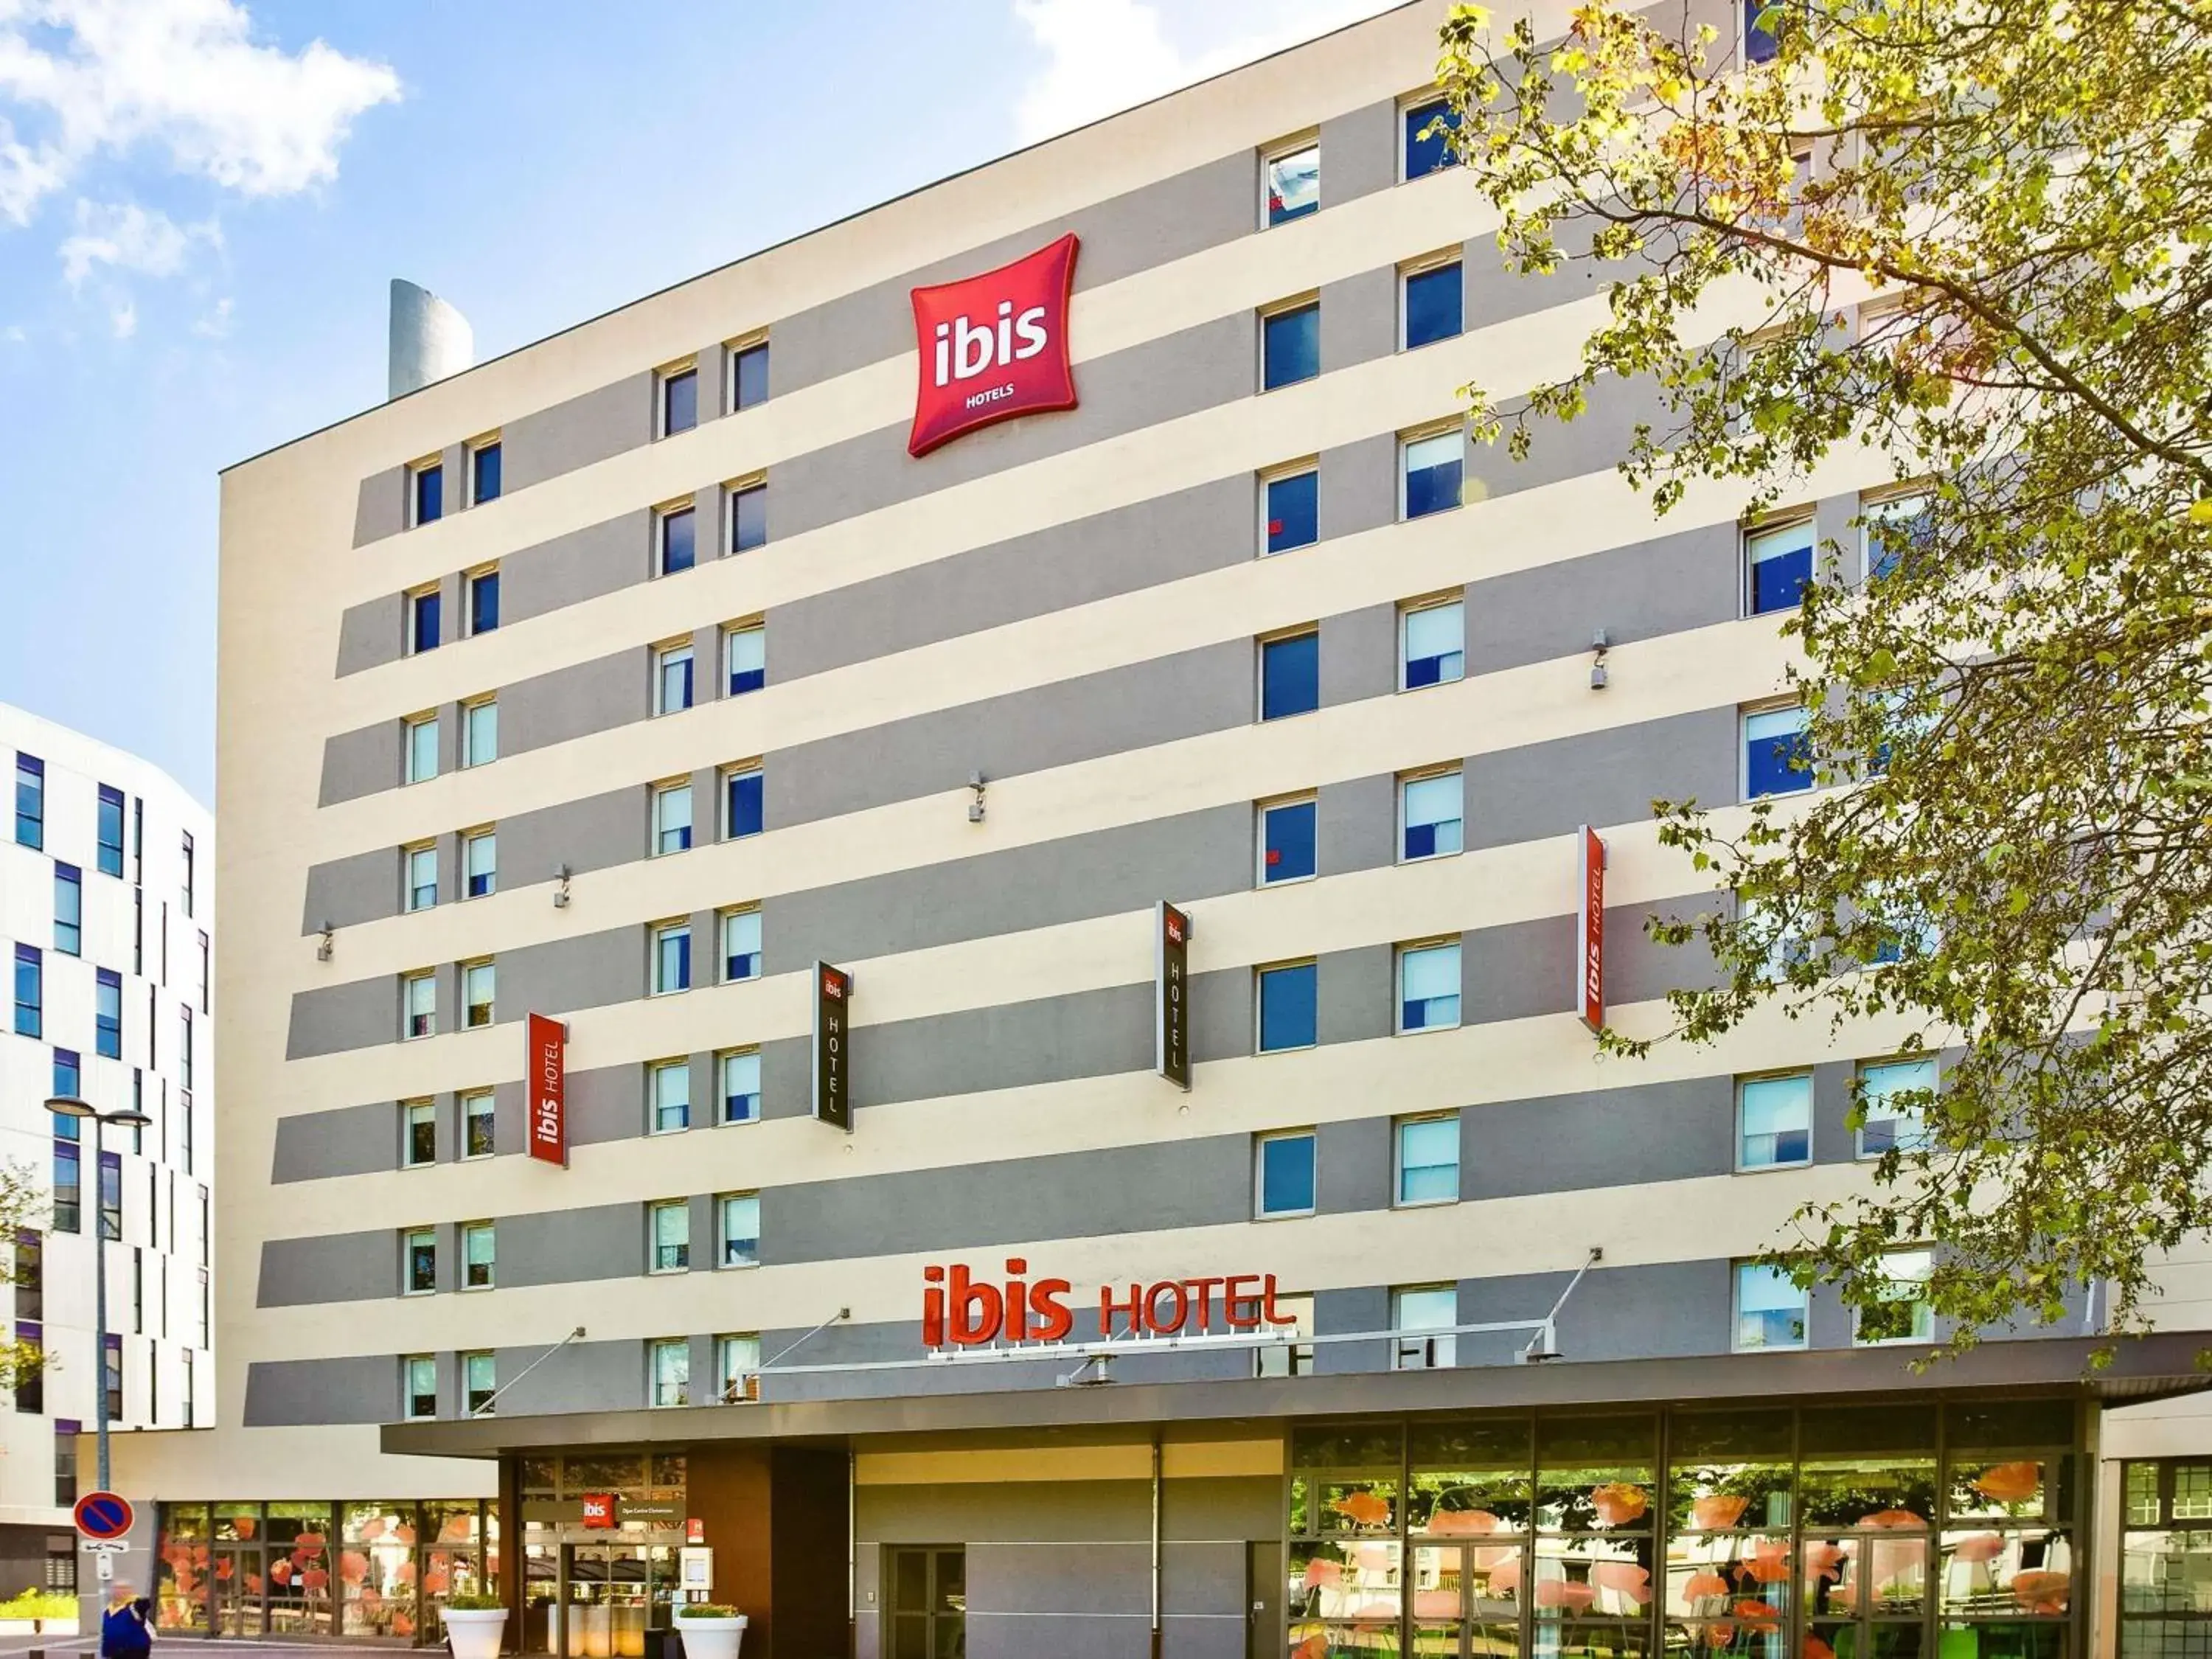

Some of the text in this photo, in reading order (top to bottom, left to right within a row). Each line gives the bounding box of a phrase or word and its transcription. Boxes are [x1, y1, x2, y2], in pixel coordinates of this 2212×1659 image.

[935, 300, 1048, 387] ibis
[966, 383, 1014, 408] HOTELS
[1588, 866, 1601, 1004] ibis HOTEL
[825, 979, 841, 998] ibis
[1171, 961, 1180, 1068] HOTEL
[537, 1040, 559, 1144] ibis HOTEL
[829, 1016, 839, 1113] HOTEL
[922, 1258, 1298, 1347] ibis HOTEL
[583, 1501, 606, 1517] ibis
